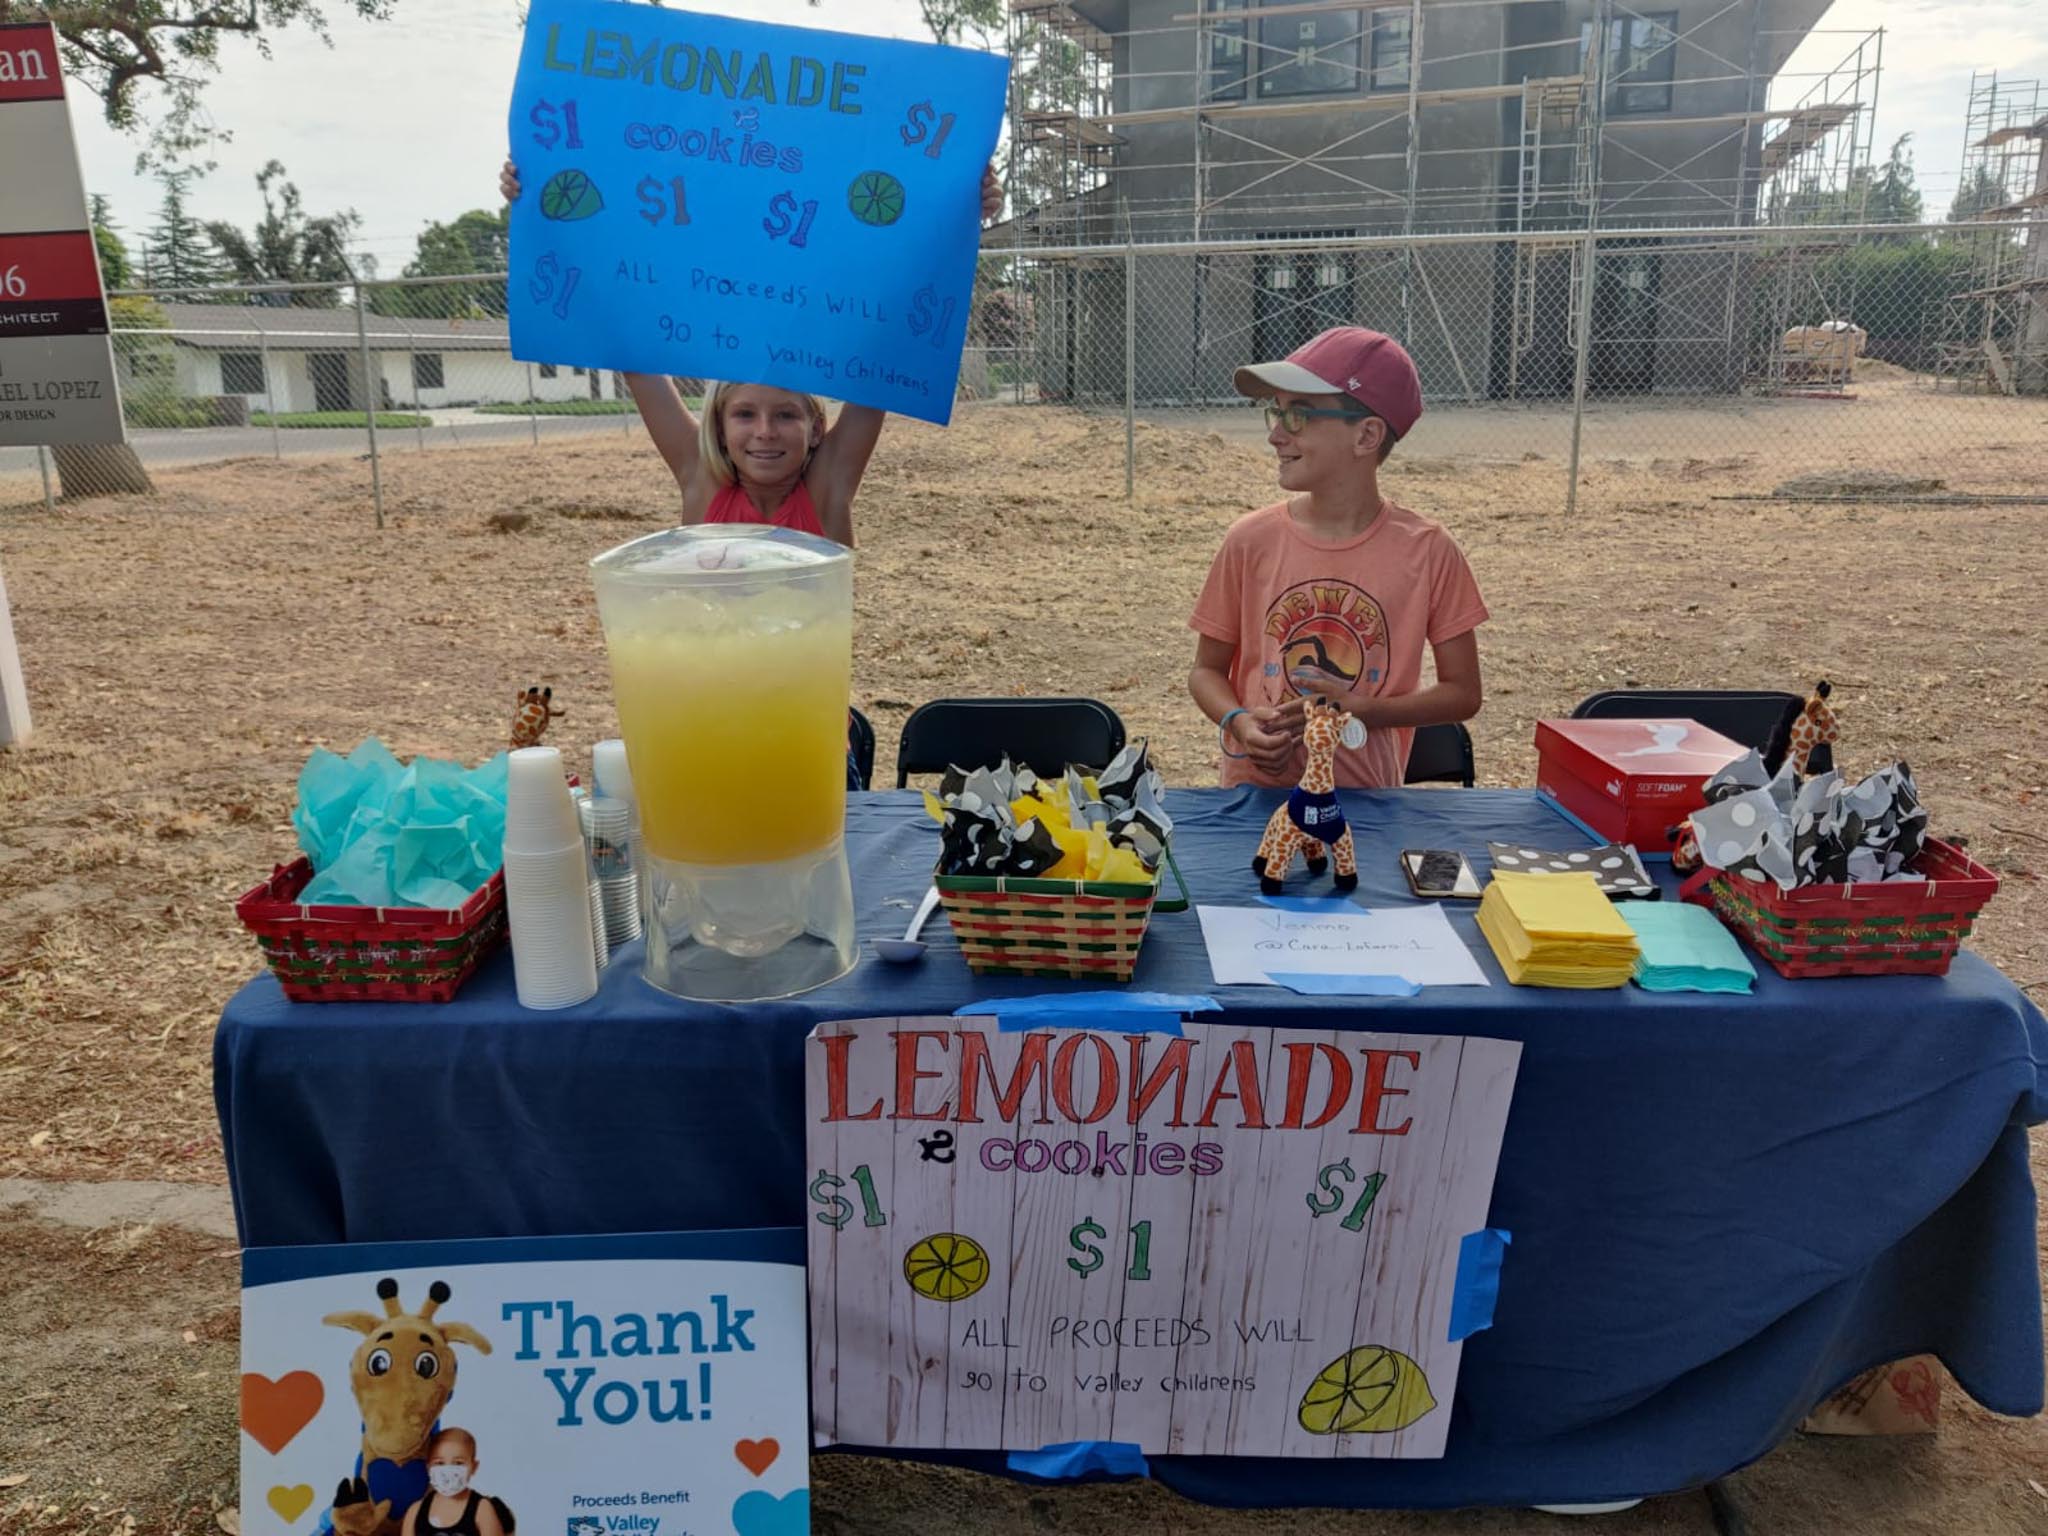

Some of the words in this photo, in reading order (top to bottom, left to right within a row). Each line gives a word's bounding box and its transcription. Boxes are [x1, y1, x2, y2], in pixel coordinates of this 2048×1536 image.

[545, 23, 866, 115] LEMONADE
[530, 98, 584, 151] $1
[624, 121, 804, 174] cookies
[900, 100, 957, 160] $1
[635, 175, 691, 226] $1
[763, 191, 818, 248] $1
[616, 260, 658, 284] ALL
[32, 381, 102, 400] LOPEZ
[1264, 586, 1386, 650] DEWEY
[819, 1031, 1421, 1136] LEMONADE
[980, 1131, 1224, 1176] cookies
[809, 1164, 887, 1231] $1
[1305, 1158, 1388, 1232] $1
[501, 1295, 757, 1361] Thank
[962, 1319, 1021, 1348] ALL
[1050, 1317, 1212, 1350] PROCEEDS
[1234, 1318, 1316, 1344] WILL
[544, 1362, 713, 1427] You!
[572, 1494, 637, 1508] Proceeds
[640, 1491, 690, 1505] Benefit
[606, 1514, 660, 1533] Valley
